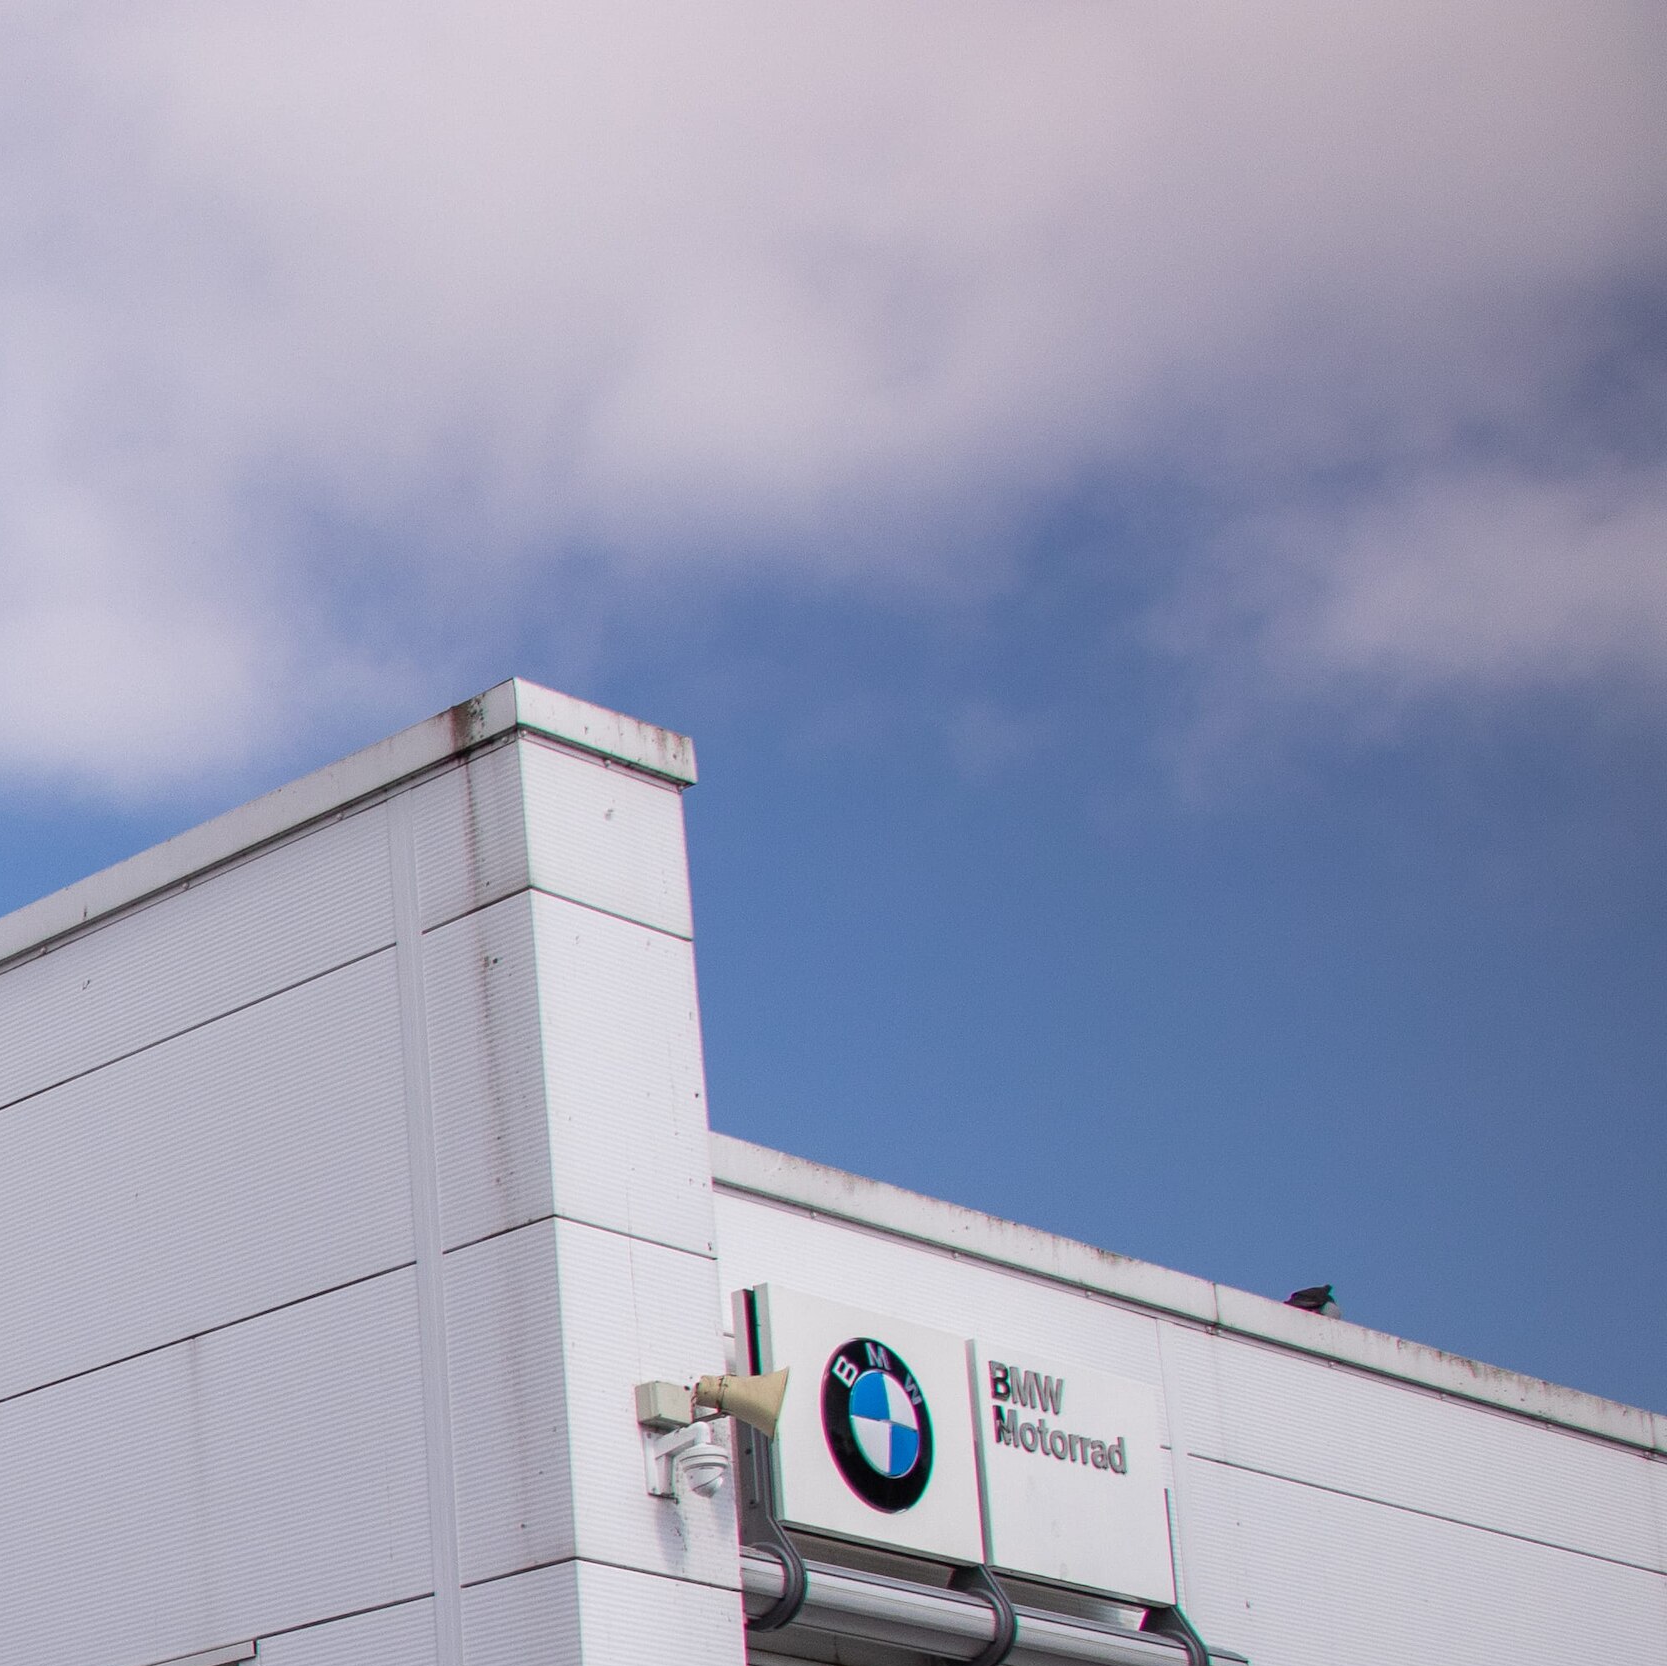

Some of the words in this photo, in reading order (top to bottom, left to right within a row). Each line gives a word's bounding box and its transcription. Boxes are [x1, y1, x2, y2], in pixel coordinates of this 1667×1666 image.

[832, 1341, 924, 1407] BMW
[988, 1360, 1065, 1416] BMW
[994, 1404, 1128, 1476] Motorrad
